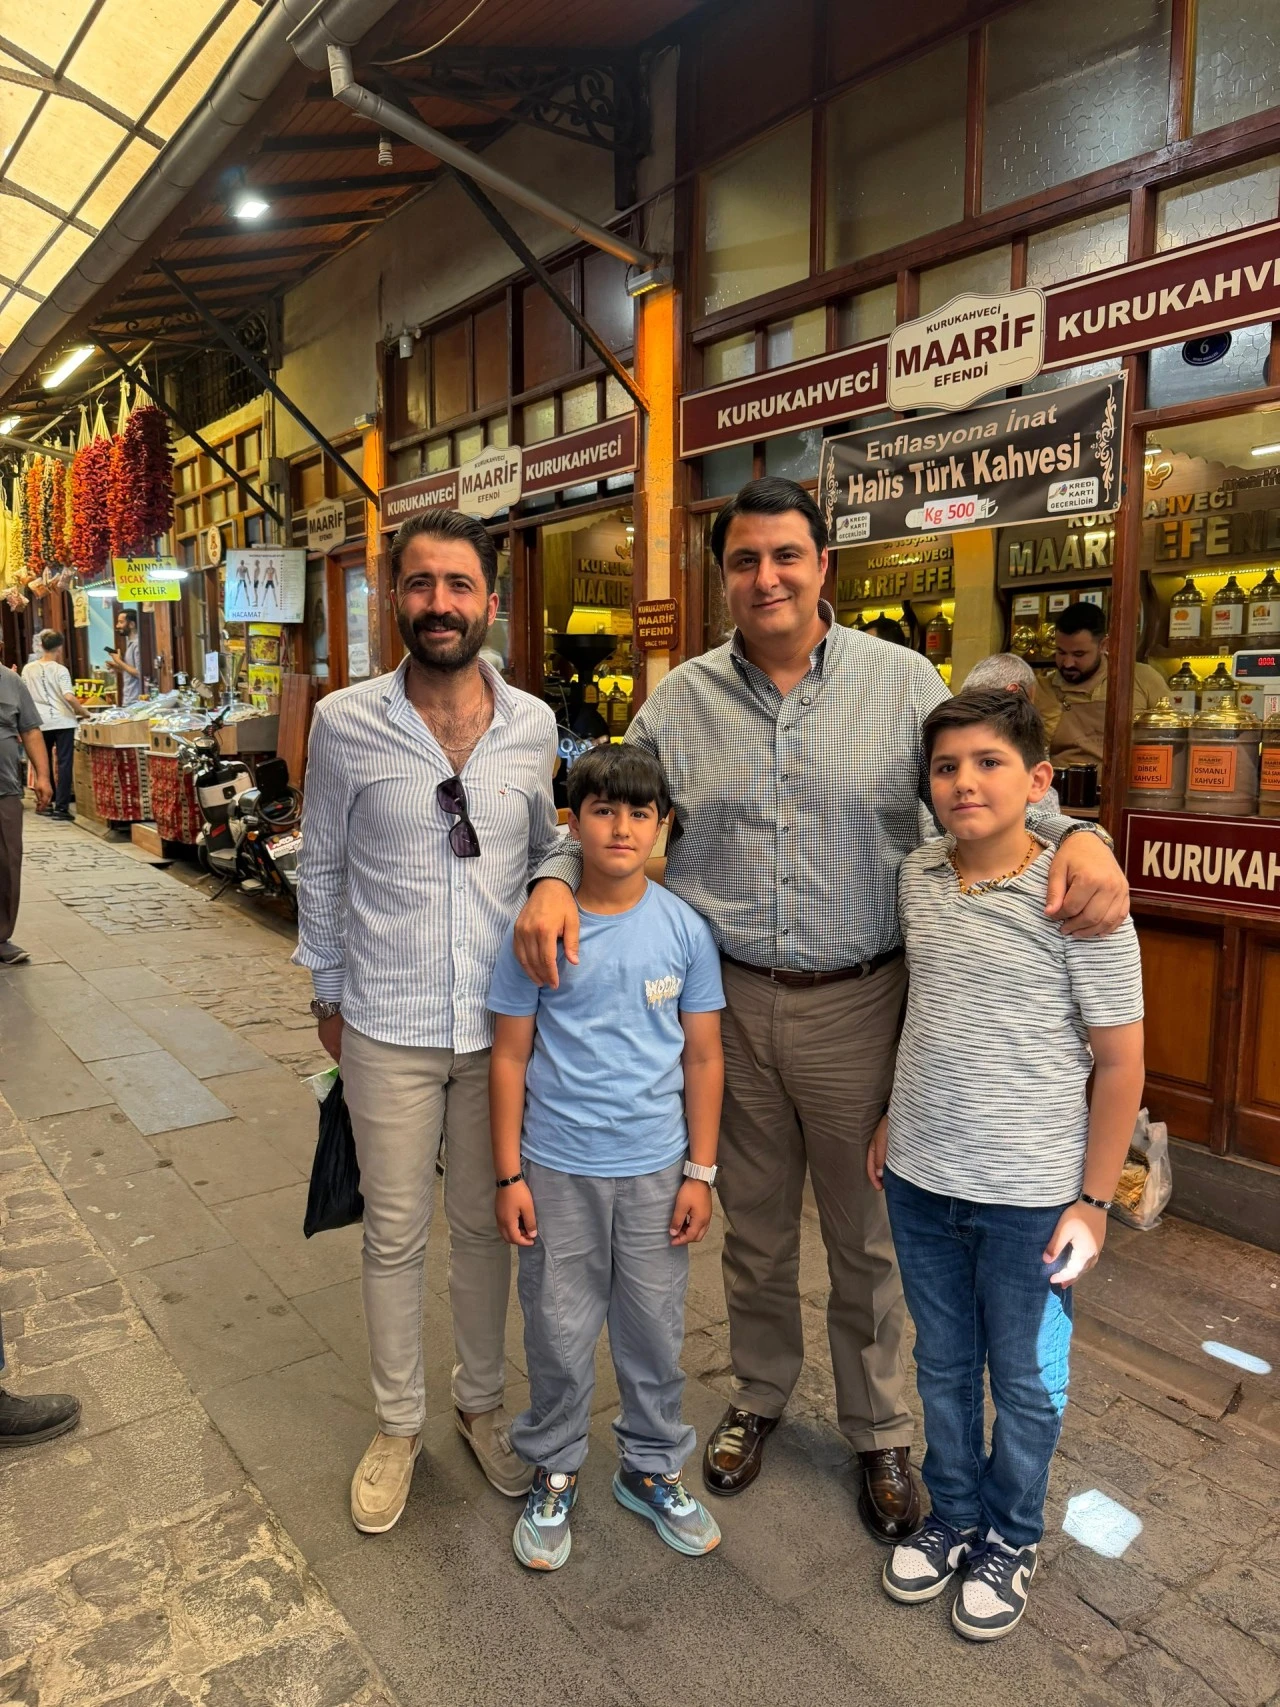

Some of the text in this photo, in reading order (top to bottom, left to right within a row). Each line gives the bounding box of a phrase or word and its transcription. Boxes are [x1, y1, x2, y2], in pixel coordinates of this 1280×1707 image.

[1058, 258, 1280, 342] KURUKAHV
[926, 304, 1001, 334] KURUKAHVECİ
[895, 313, 1036, 378] MAARİF
[934, 362, 988, 388] EFENDİ
[717, 362, 879, 430] KURUKAHVECİ
[866, 421, 997, 462] Enflasyona
[462, 460, 518, 495] MAARİF
[525, 438, 622, 482] KURUKAHVECİ
[848, 432, 1081, 506] Halis Türk Kahvesi
[387, 482, 456, 517] KURUKAHVECİ
[925, 507, 943, 525] Kg
[948, 502, 975, 519] 500
[309, 510, 343, 534] MAARİF
[1009, 530, 1115, 577] MAARİ
[638, 614, 675, 626] MAARİF
[640, 625, 674, 637] EFENDİ
